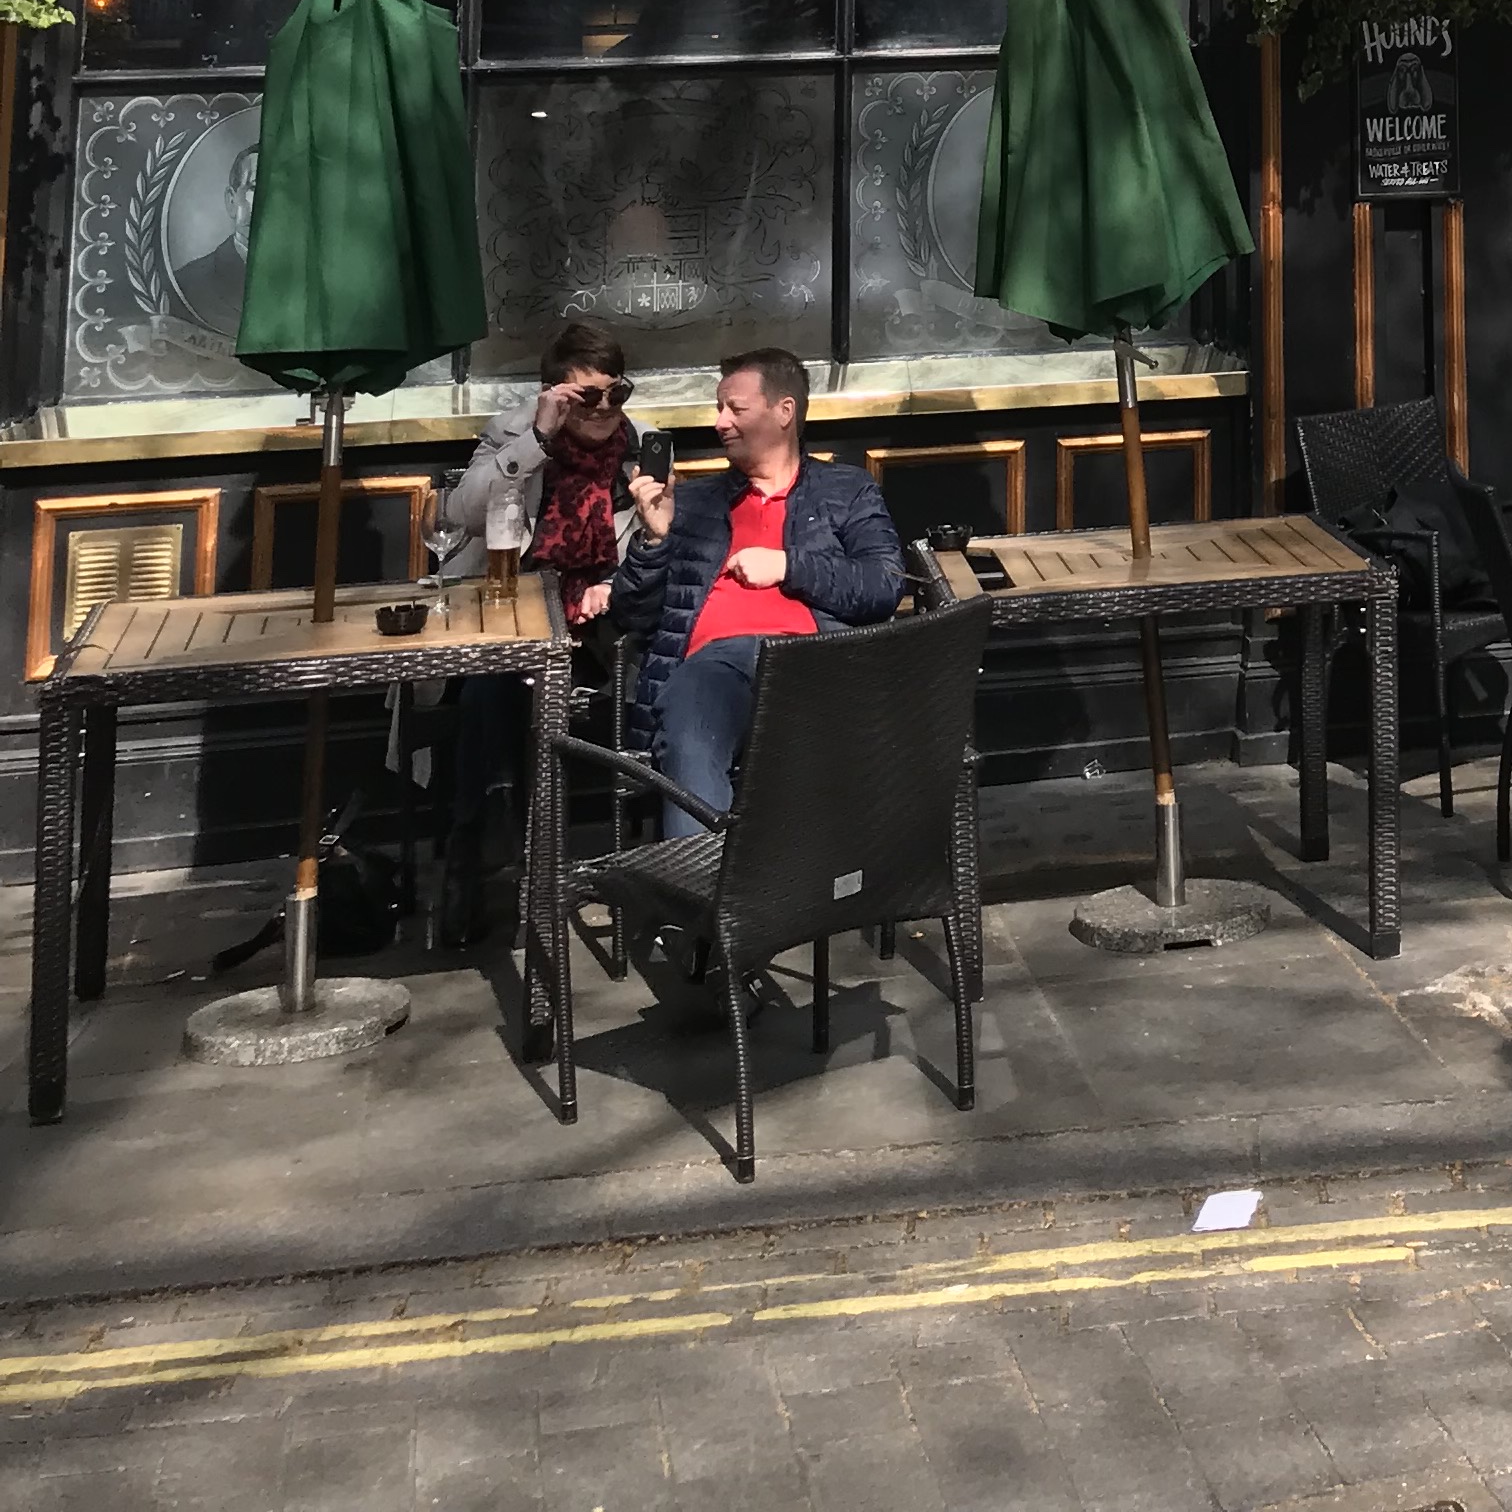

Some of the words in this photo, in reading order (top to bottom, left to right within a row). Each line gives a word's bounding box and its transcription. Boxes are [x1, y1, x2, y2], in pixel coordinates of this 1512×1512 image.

[1366, 113, 1447, 143] WELCOME
[1368, 162, 1401, 178] WATER
[1410, 159, 1449, 176] TREATS
